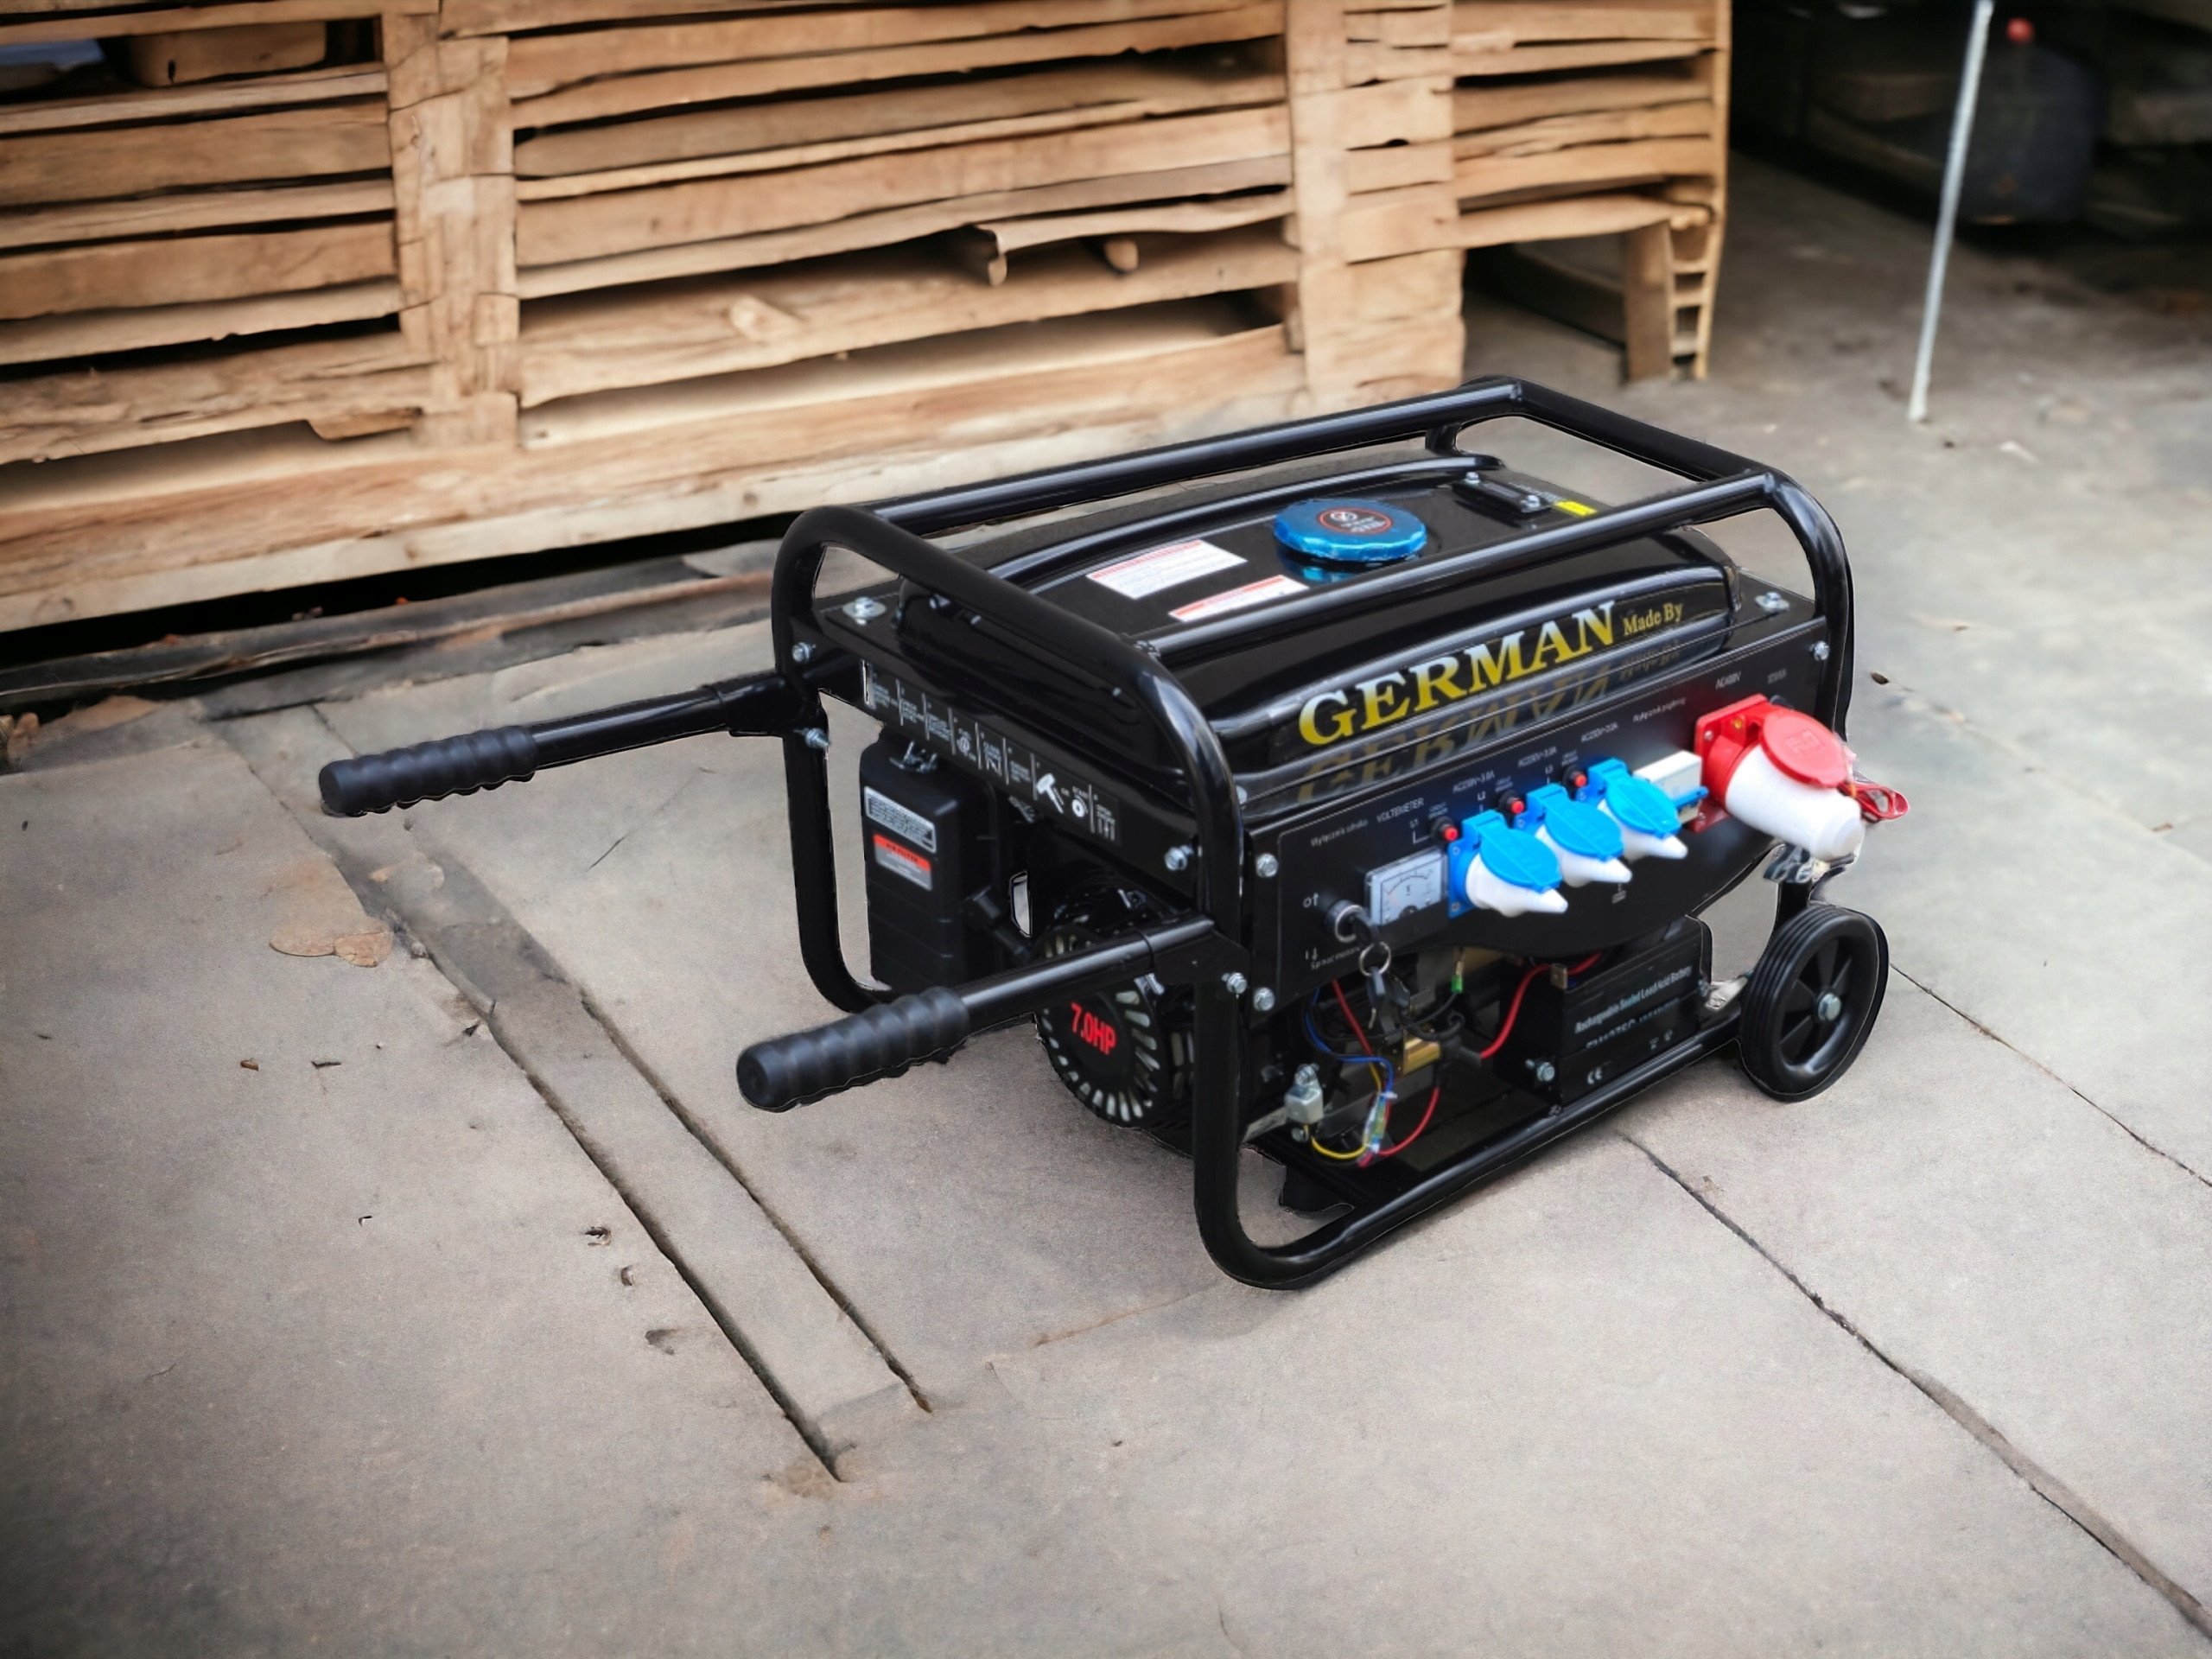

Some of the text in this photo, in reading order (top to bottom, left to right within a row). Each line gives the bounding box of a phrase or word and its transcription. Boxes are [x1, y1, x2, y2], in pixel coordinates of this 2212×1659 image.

[1298, 601, 1683, 746] GERMAN Made By
[1071, 1002, 1116, 1055] 7.0HP
